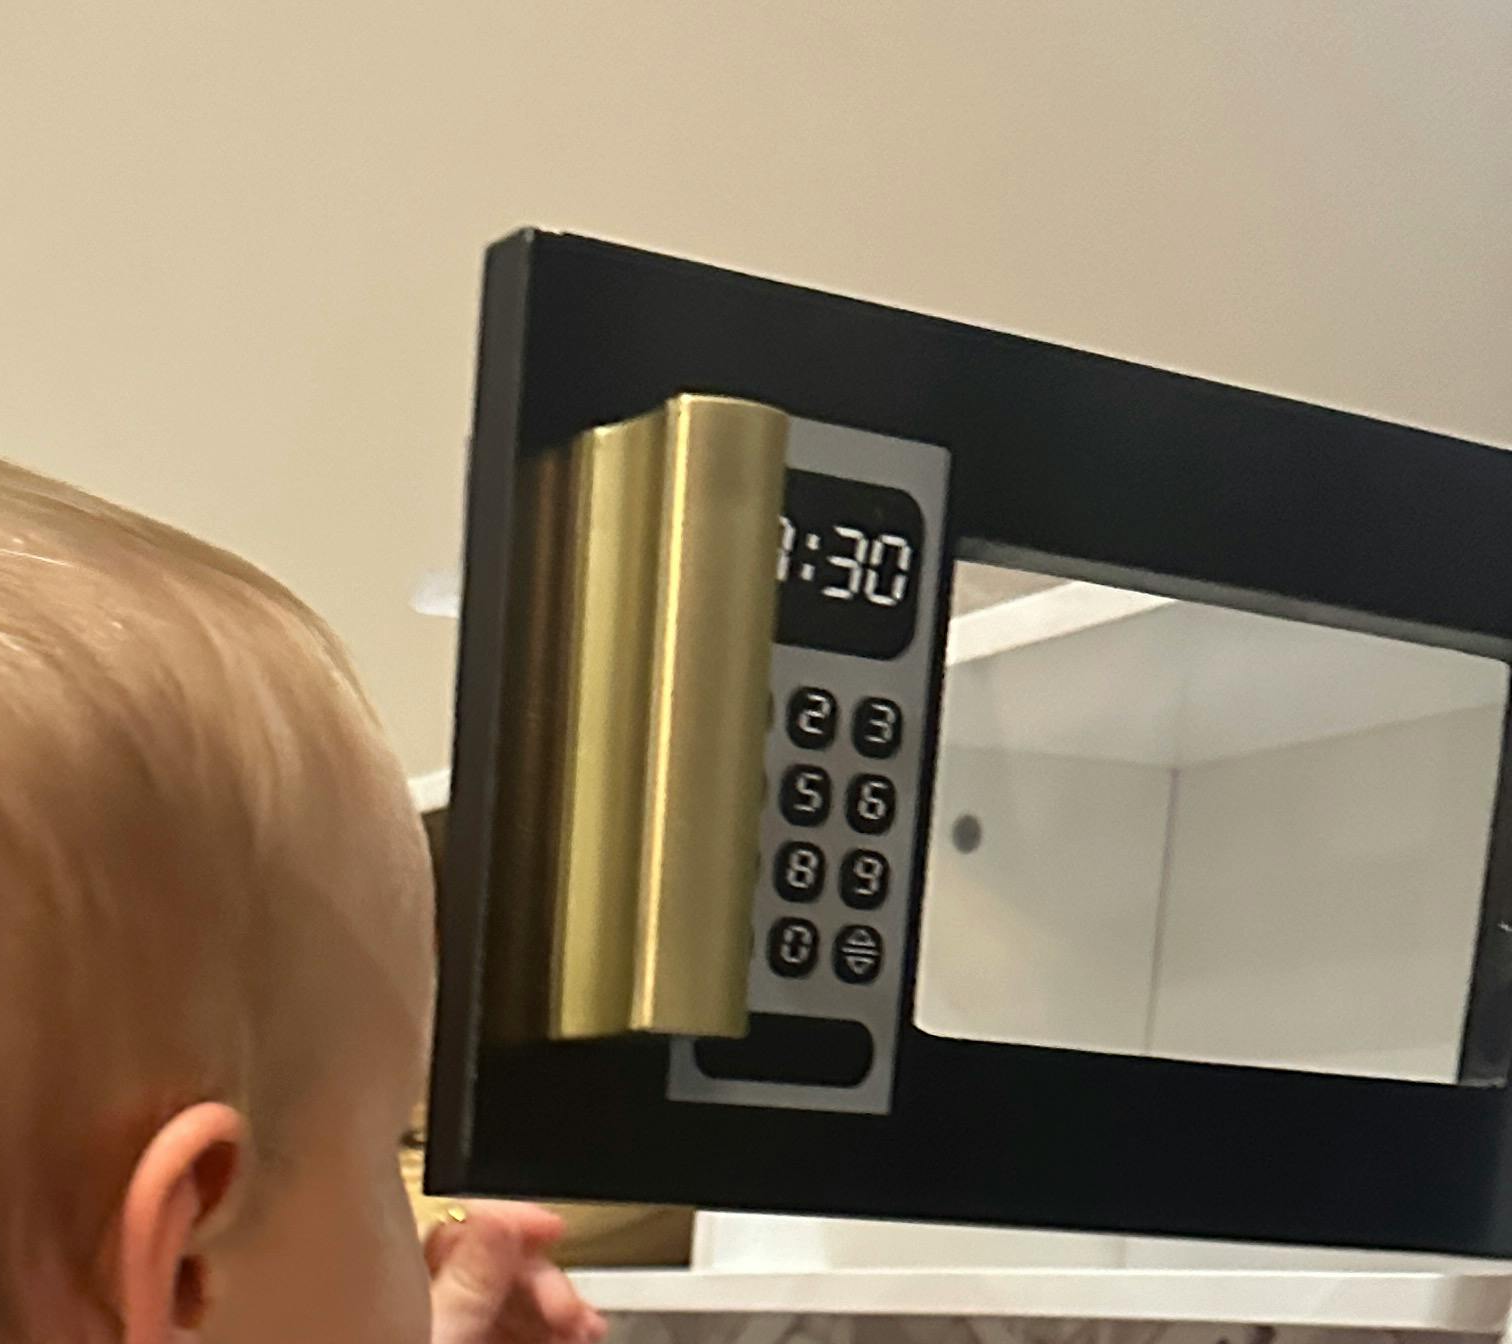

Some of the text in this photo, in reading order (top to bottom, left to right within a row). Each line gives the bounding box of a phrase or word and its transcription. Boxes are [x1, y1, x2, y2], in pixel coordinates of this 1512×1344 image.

[799, 694, 895, 744] 2 3
[796, 772, 887, 821] 5 6
[787, 849, 881, 896] 8 9
